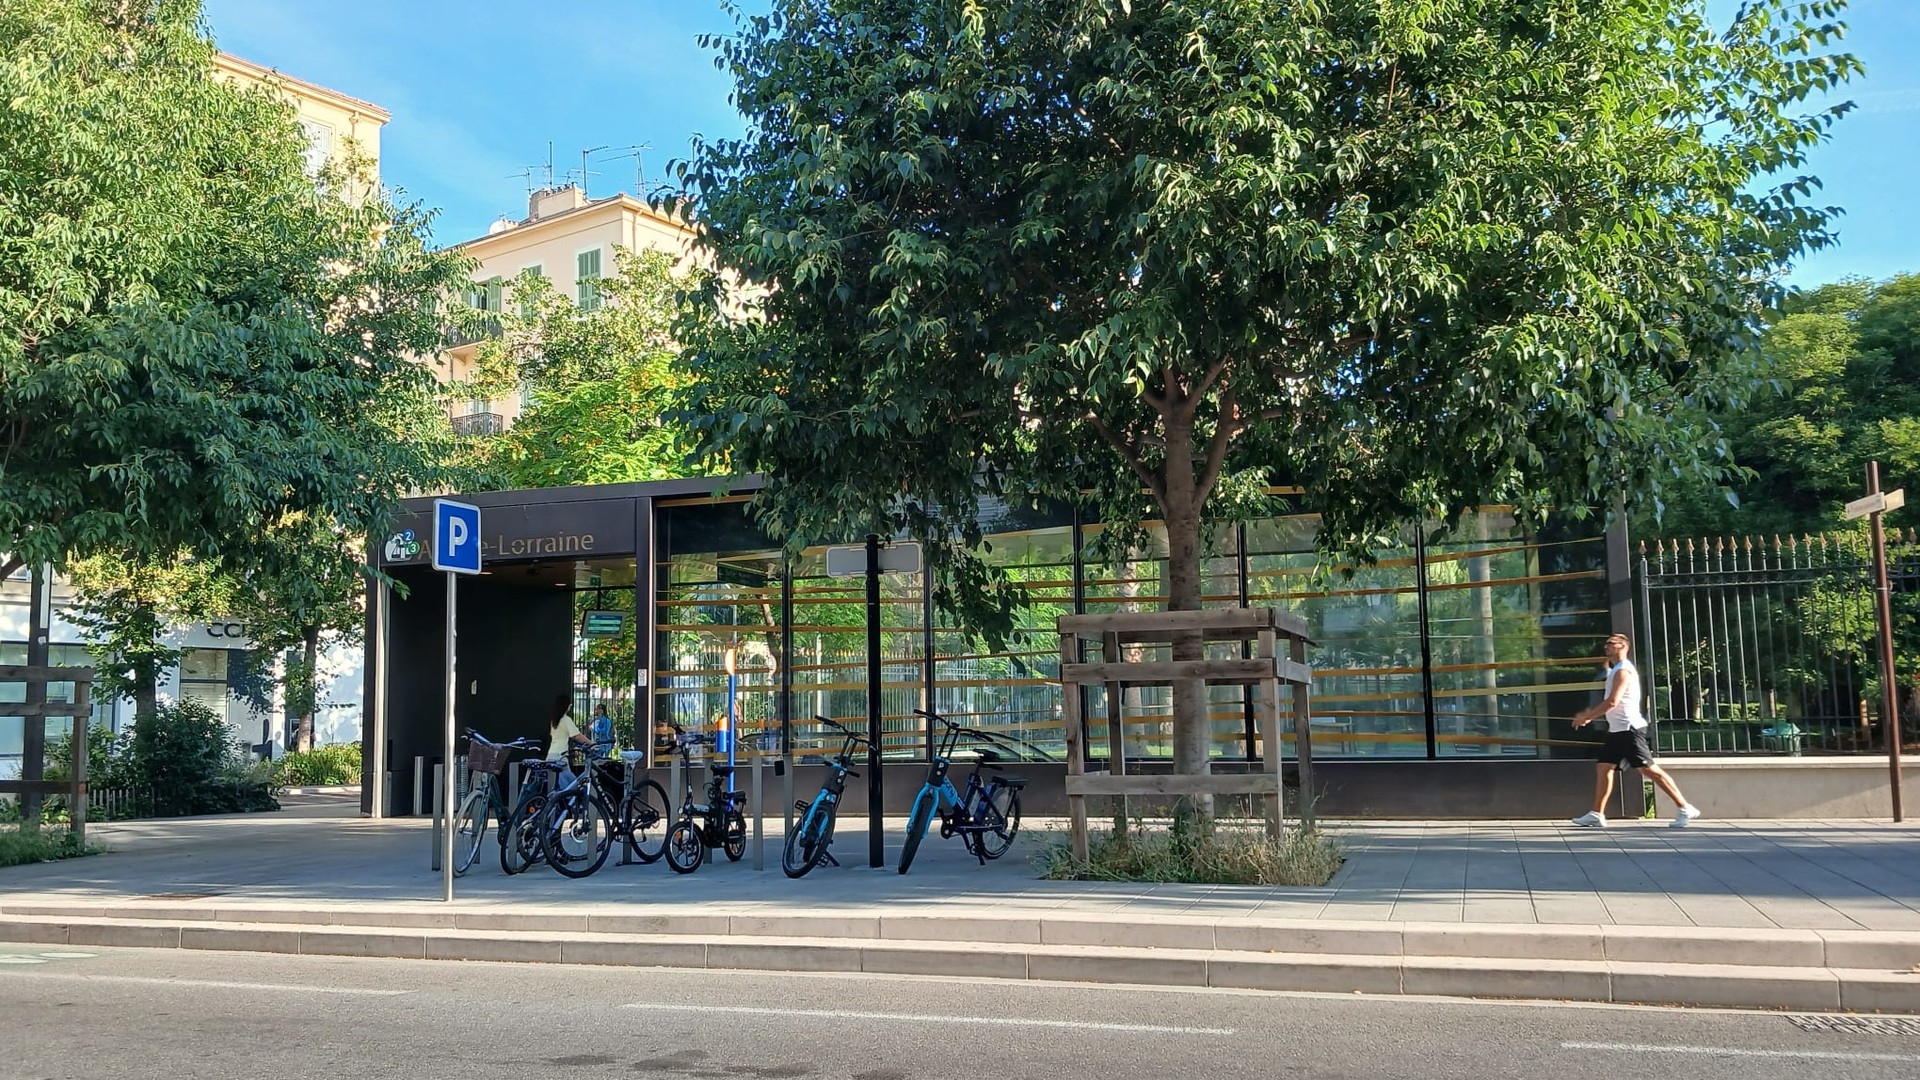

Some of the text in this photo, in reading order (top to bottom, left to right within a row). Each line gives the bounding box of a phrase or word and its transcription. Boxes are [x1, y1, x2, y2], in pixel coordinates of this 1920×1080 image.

[405, 531, 411, 541] 2
[449, 516, 468, 557] P
[411, 544, 418, 553] 3
